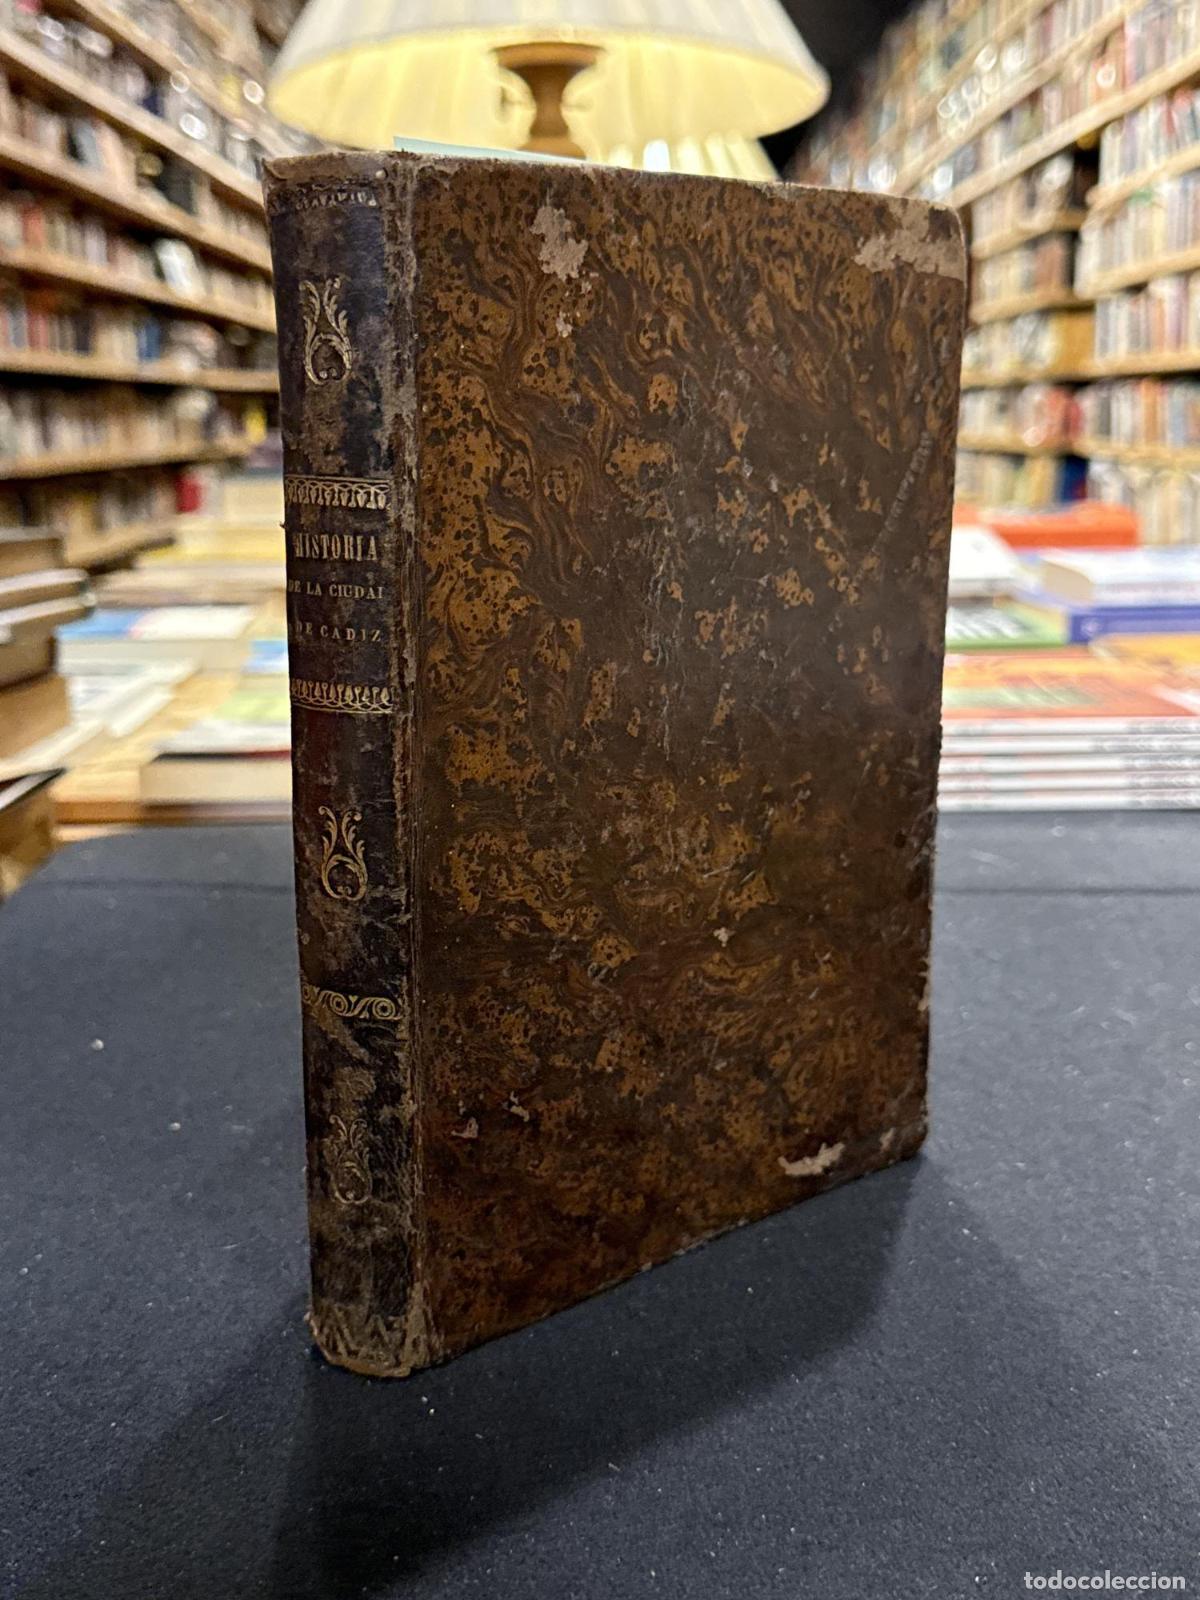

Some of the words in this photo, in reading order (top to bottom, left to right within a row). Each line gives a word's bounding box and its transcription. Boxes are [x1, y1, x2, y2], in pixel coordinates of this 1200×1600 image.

[293, 532, 378, 562] HISTORIA
[288, 579, 301, 593] DE
[306, 581, 322, 596] LA
[320, 624, 381, 642] CADIZ
